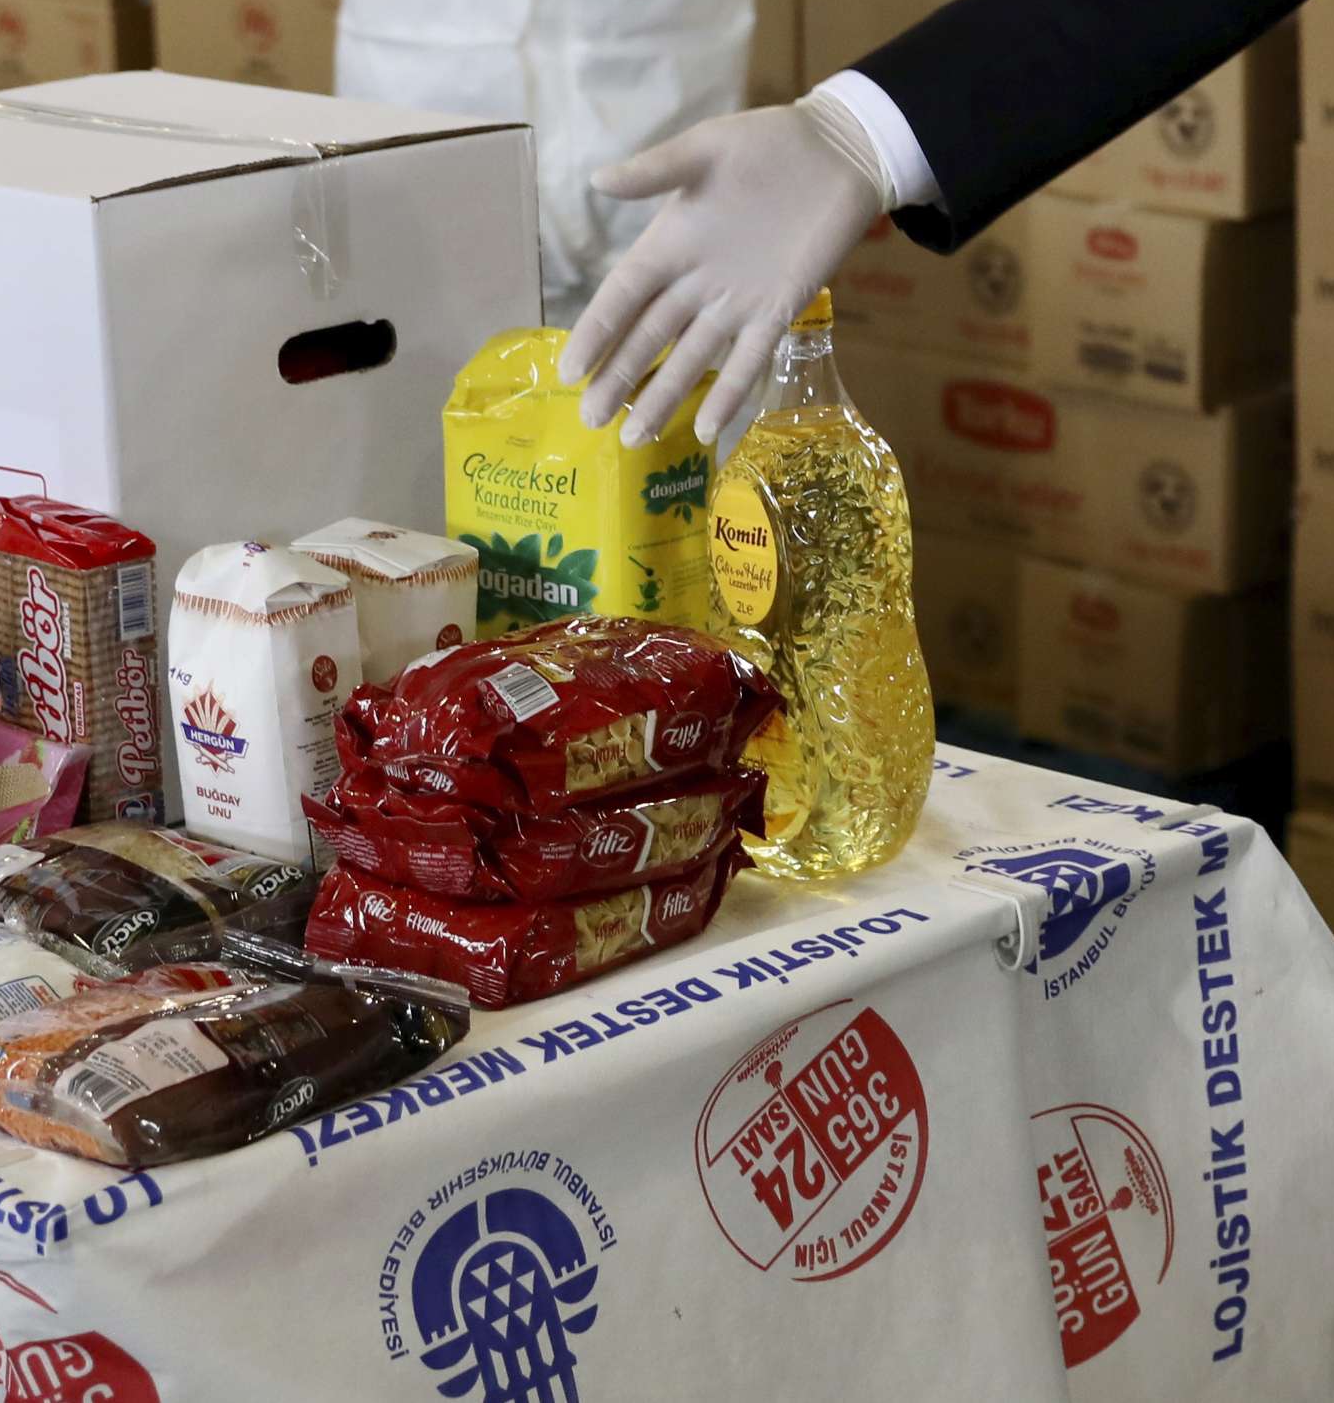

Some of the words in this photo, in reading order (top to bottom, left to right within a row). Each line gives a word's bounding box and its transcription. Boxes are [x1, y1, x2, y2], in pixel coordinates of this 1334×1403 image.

[463, 453, 578, 497] Geleneksel
[474, 483, 559, 519] Karadeniz
[715, 515, 768, 552] Komili
[479, 567, 579, 608] oğadan
[18, 569, 69, 745] tibör
[117, 650, 156, 787] Petibör
[190, 728, 236, 751] HERGÜN
[196, 785, 240, 807] BUĞDAY
[208, 804, 232, 820] UNU
[589, 829, 635, 859] filiz
[661, 890, 695, 921] filiz
[713, 907, 931, 990] LOJİSTİK
[1044, 925, 1117, 1000] İSTANBUL
[517, 972, 724, 1065] DESTEK
[1193, 886, 1243, 1108] DESTEK
[287, 1045, 528, 1168] MERKEZİ
[796, 1028, 870, 1117] GÜN
[730, 1099, 791, 1177] SAAT
[826, 1069, 900, 1166] 365
[427, 1150, 550, 1211] BÜYÜKŞEHİR
[554, 1157, 617, 1252] İSTANBUL
[750, 1125, 826, 1233] 24
[839, 1132, 913, 1250] İSTANBUL
[1053, 1147, 1100, 1219] SAAT
[794, 1234, 839, 1271] İÇİN
[1070, 1229, 1130, 1316] GÜN
[1203, 1119, 1251, 1362] LOJİSTİK
[378, 1209, 427, 1361] BELEDİYESİ
